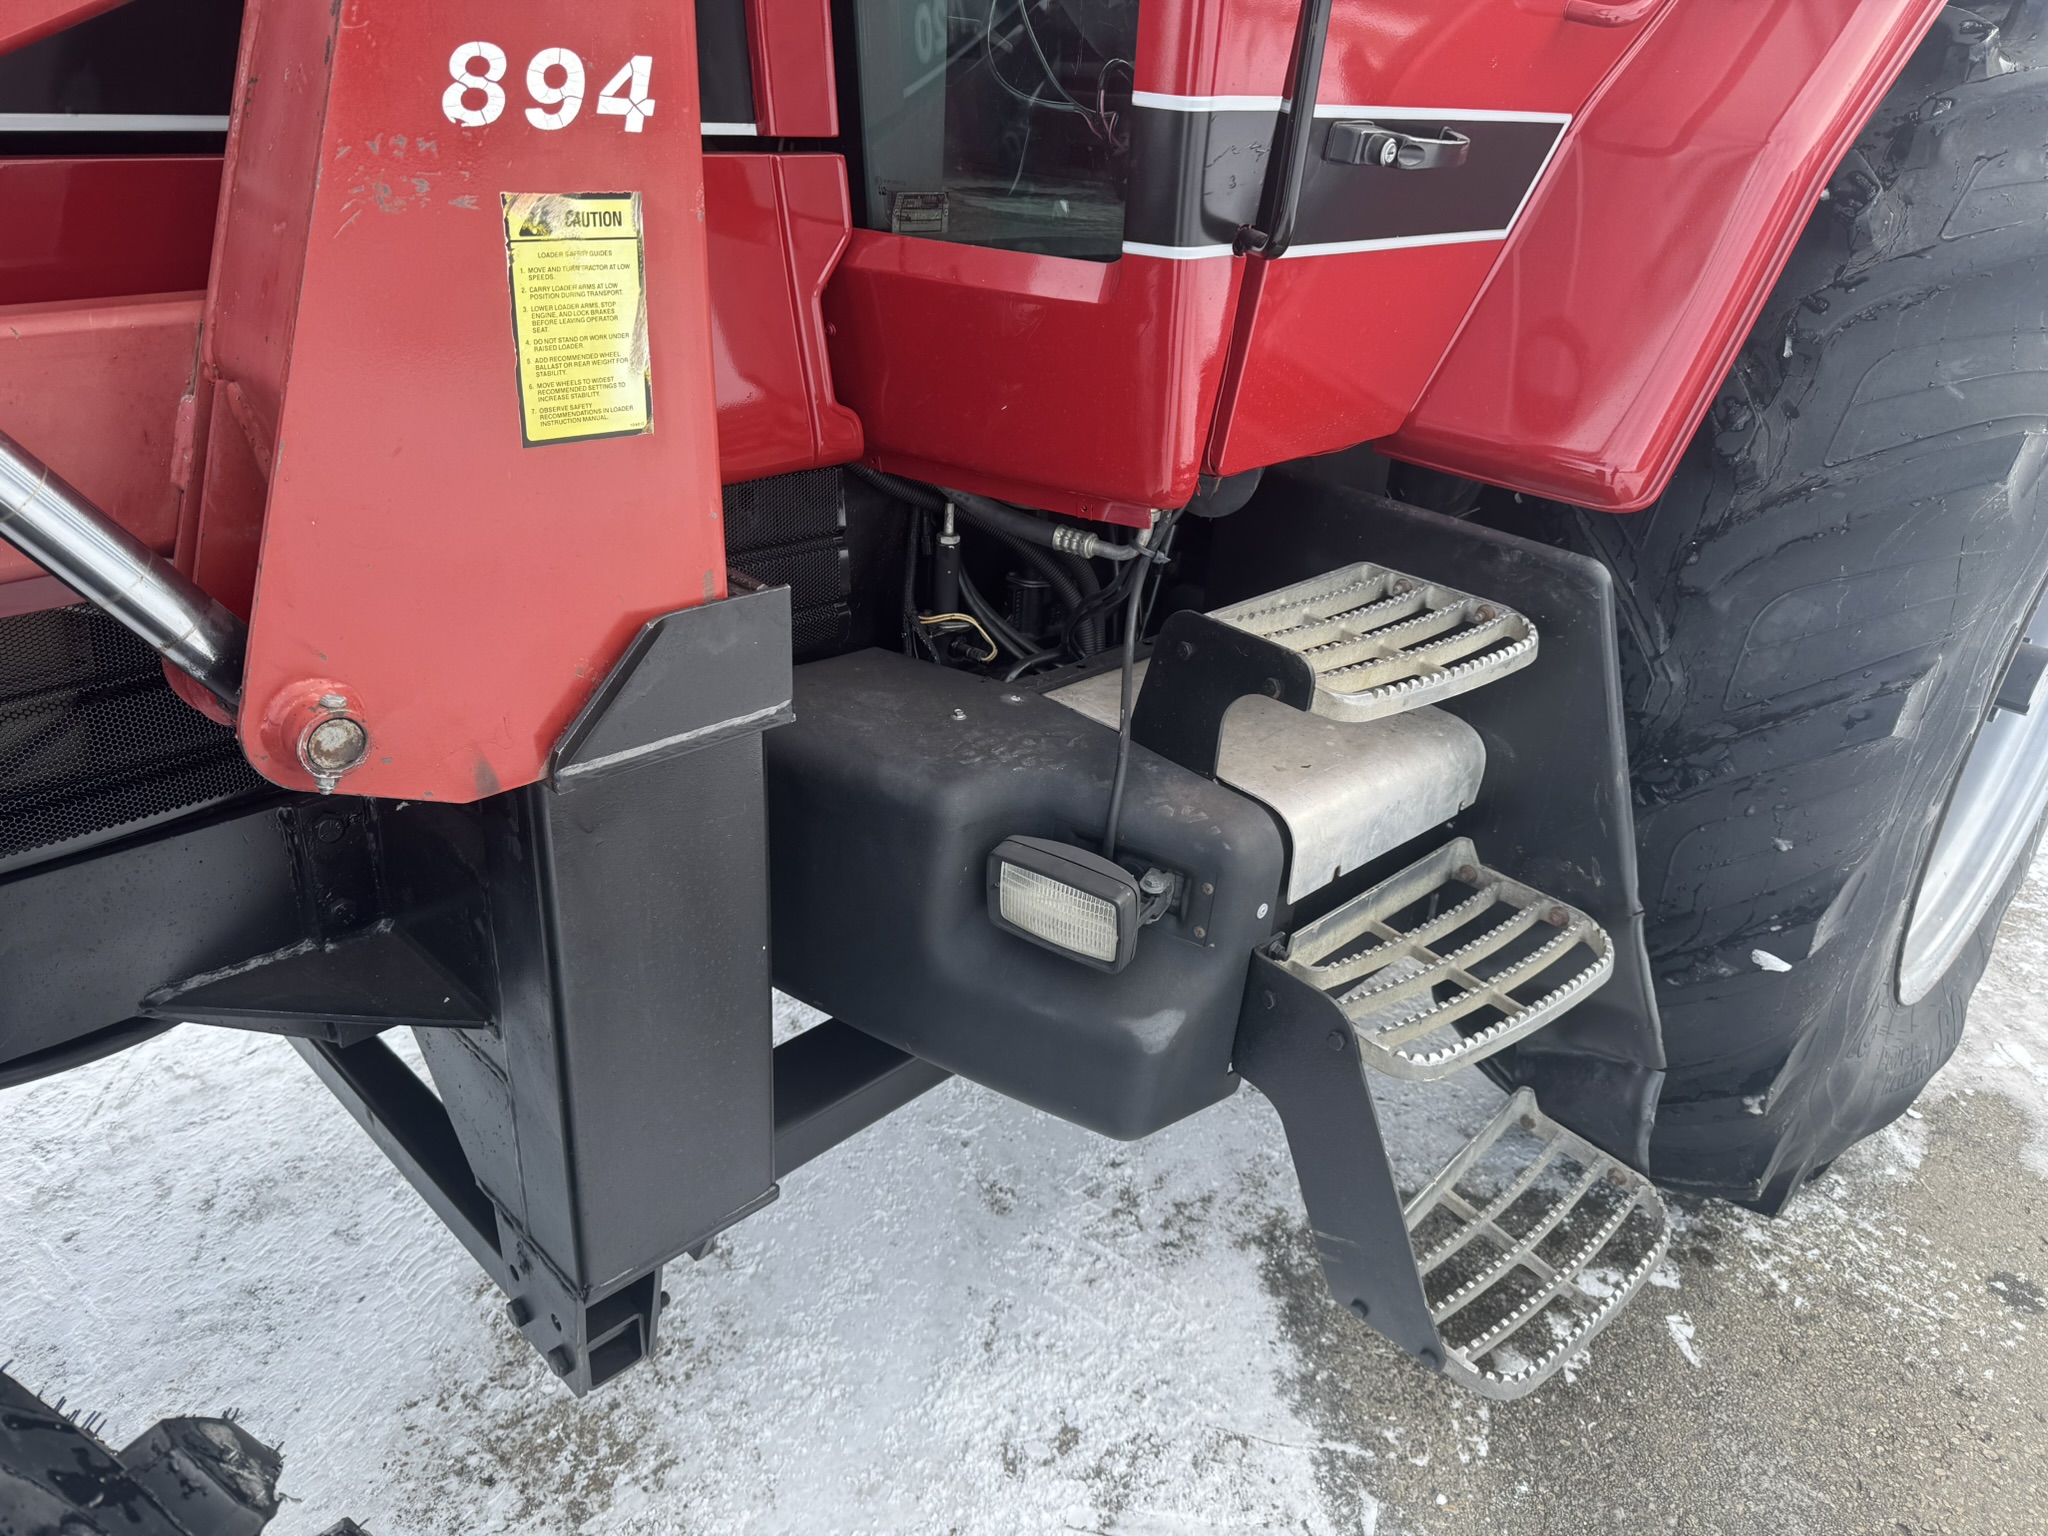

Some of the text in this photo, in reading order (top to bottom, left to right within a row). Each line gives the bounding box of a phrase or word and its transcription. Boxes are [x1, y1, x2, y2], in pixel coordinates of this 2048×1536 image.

[442, 41, 656, 133] 894
[565, 210, 622, 228] CAUTION
[549, 354, 598, 363] RECOMMENDED
[538, 386, 588, 396] RECOMMENDED
[588, 383, 618, 391] SETTINGS
[556, 380, 582, 388] WHEELS
[538, 394, 570, 402] INCREASE
[540, 408, 602, 420] RECOMMENDATIONS
[610, 405, 634, 413] LOADER
[540, 418, 584, 427] INSTRUCTION
